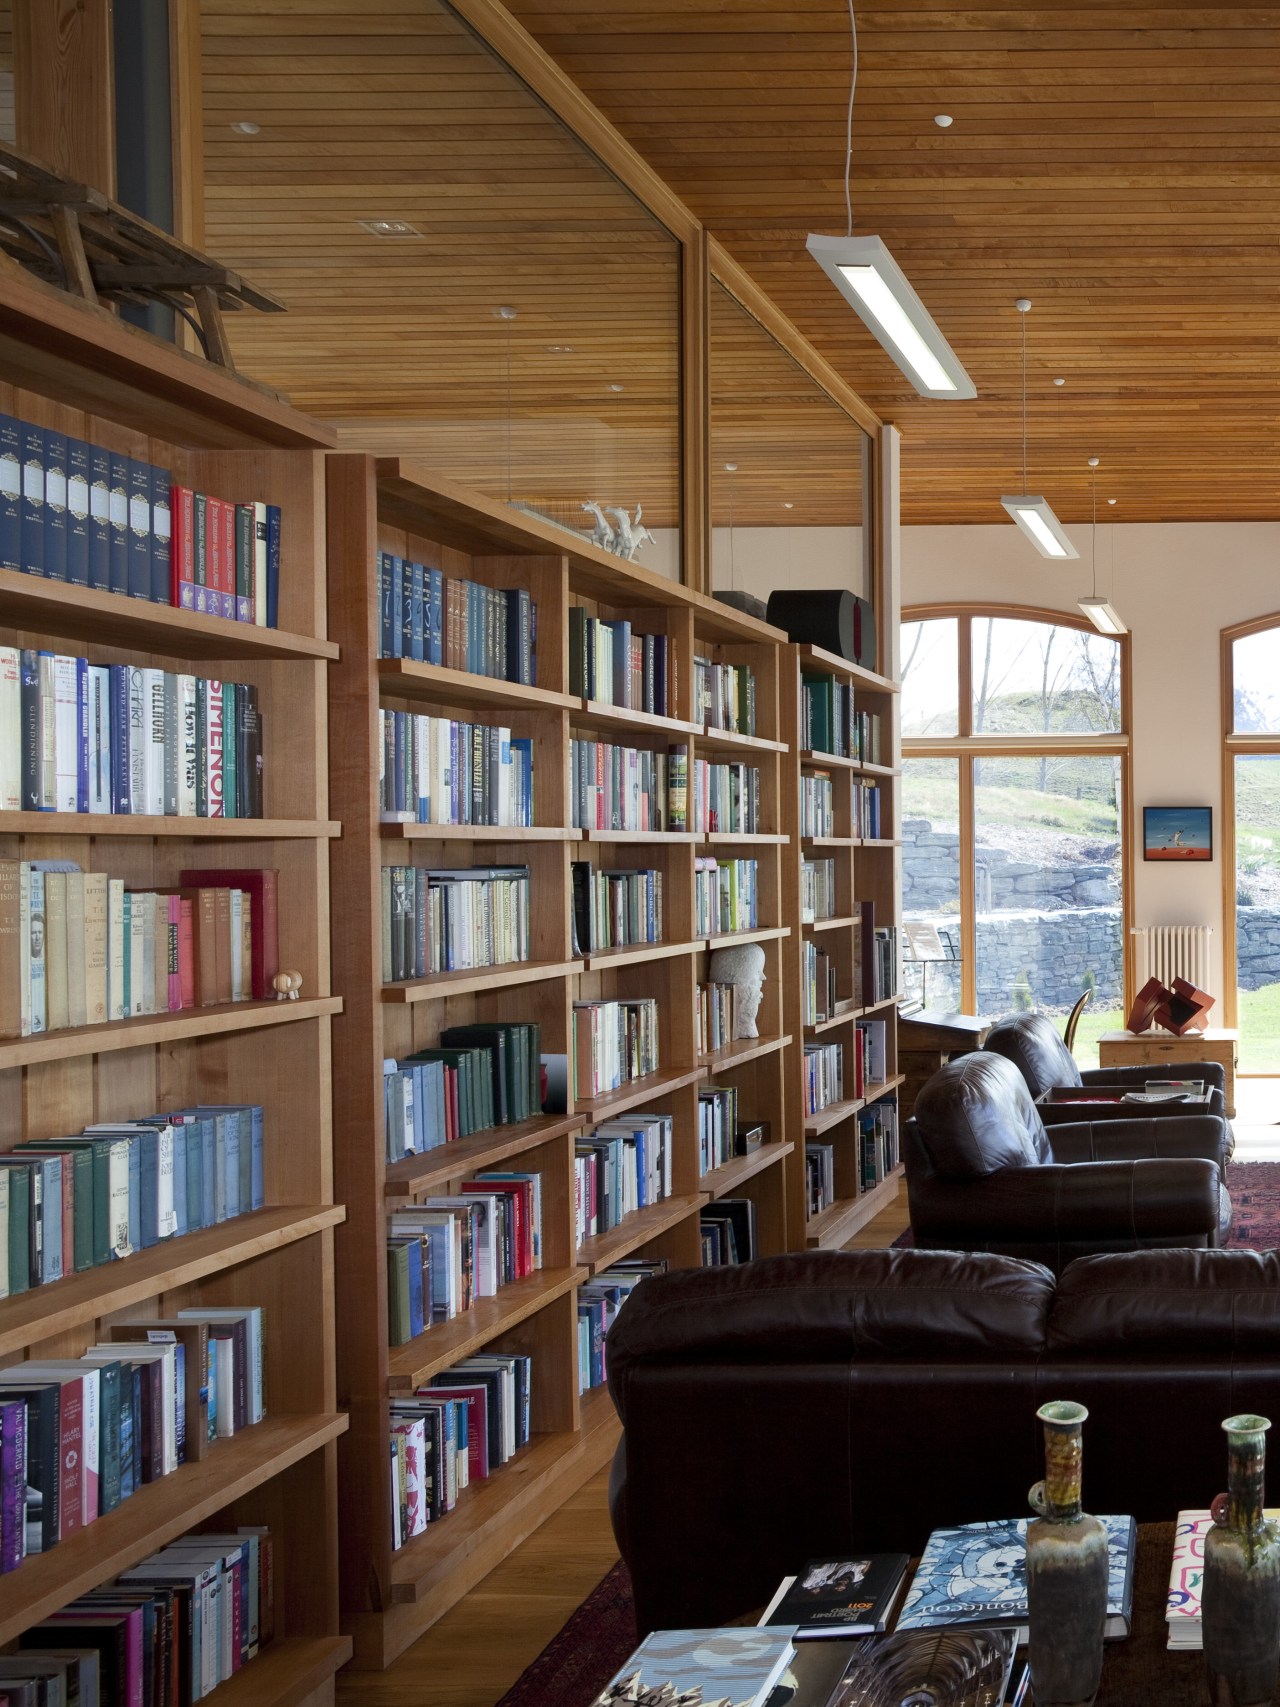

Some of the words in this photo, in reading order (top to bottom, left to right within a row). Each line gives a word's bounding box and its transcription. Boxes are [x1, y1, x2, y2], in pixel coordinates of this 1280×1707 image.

[152, 684, 164, 744] GELLHORN
[210, 680, 222, 818] SIMENON
[88, 1377, 96, 1414] JONATHAN
[63, 1428, 80, 1439] HILARY
[65, 1481, 77, 1489] HALL
[919, 1602, 1028, 1614] Bontecou
